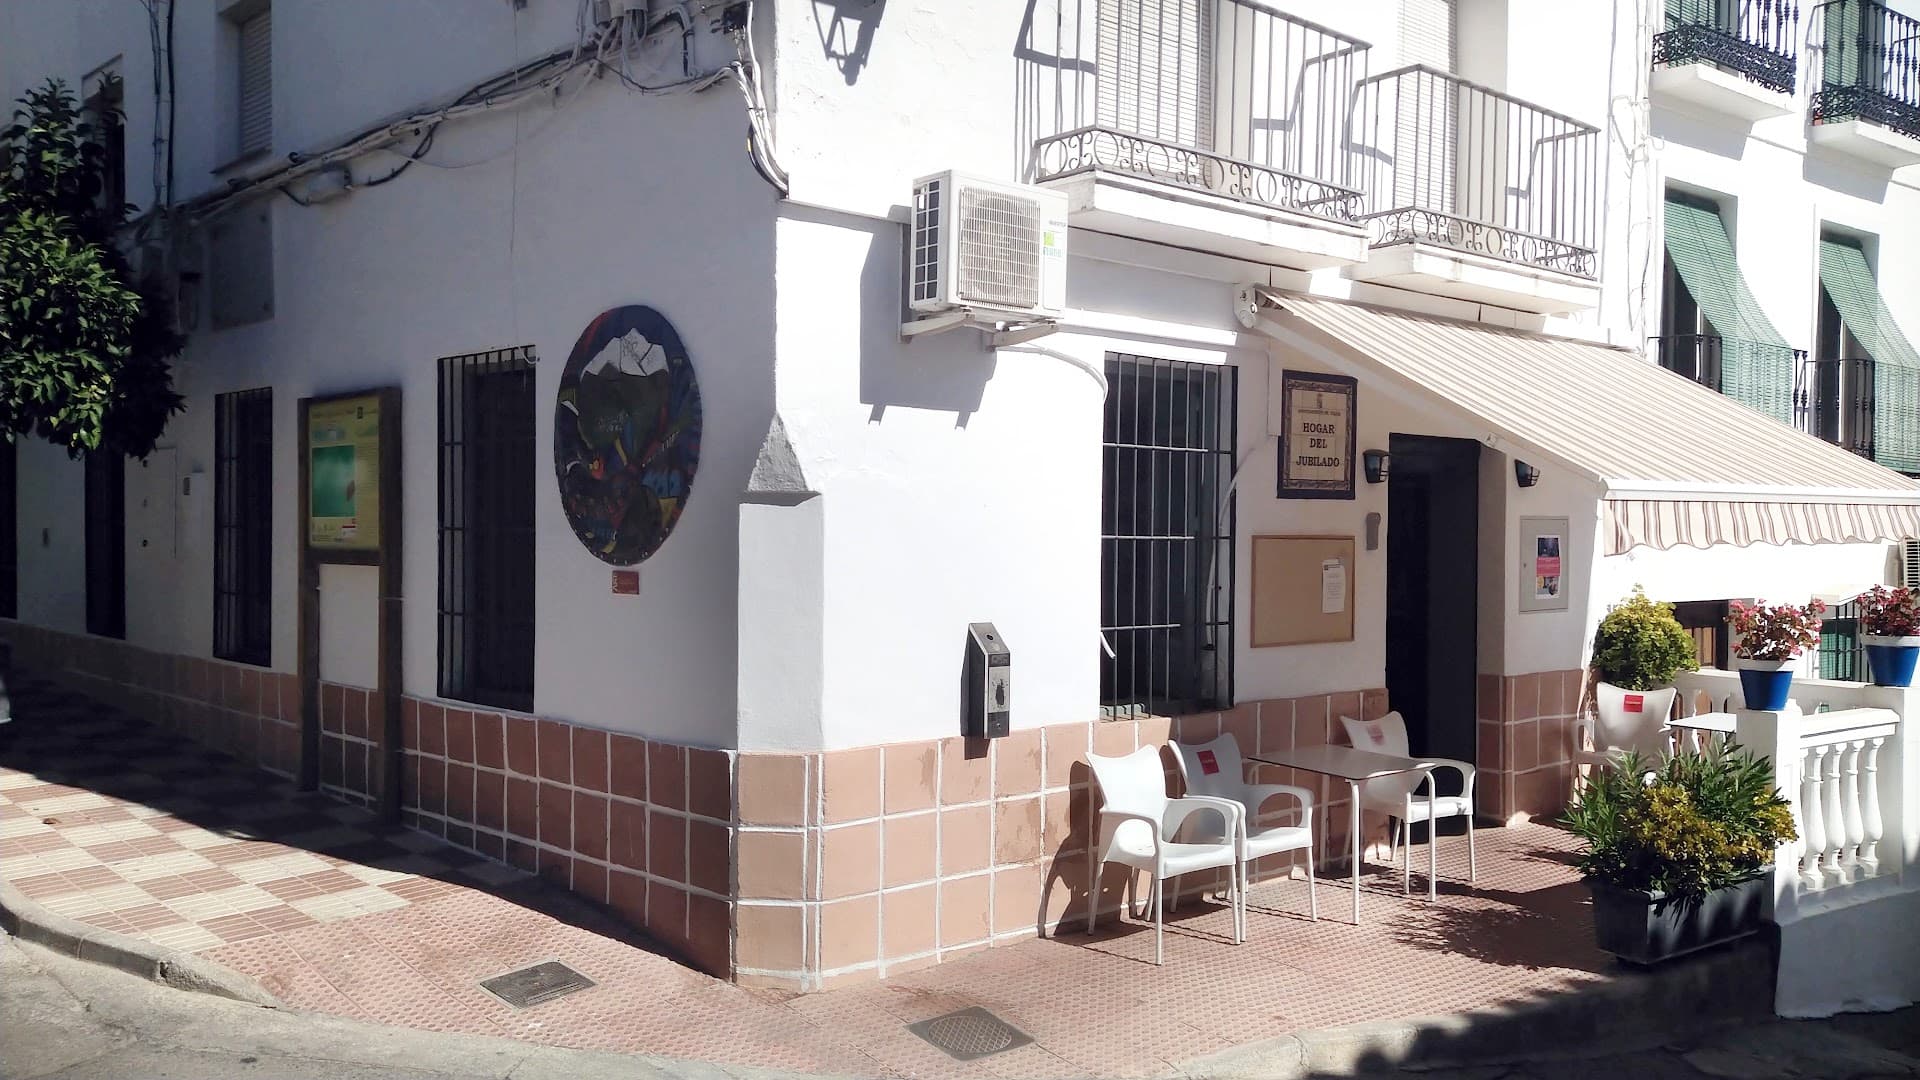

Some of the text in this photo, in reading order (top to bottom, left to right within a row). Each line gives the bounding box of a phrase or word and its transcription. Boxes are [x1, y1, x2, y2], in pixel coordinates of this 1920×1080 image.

[1303, 423, 1335, 433] HOGAR
[1309, 438, 1328, 448] DEL
[1296, 456, 1339, 467] JUBILADO
